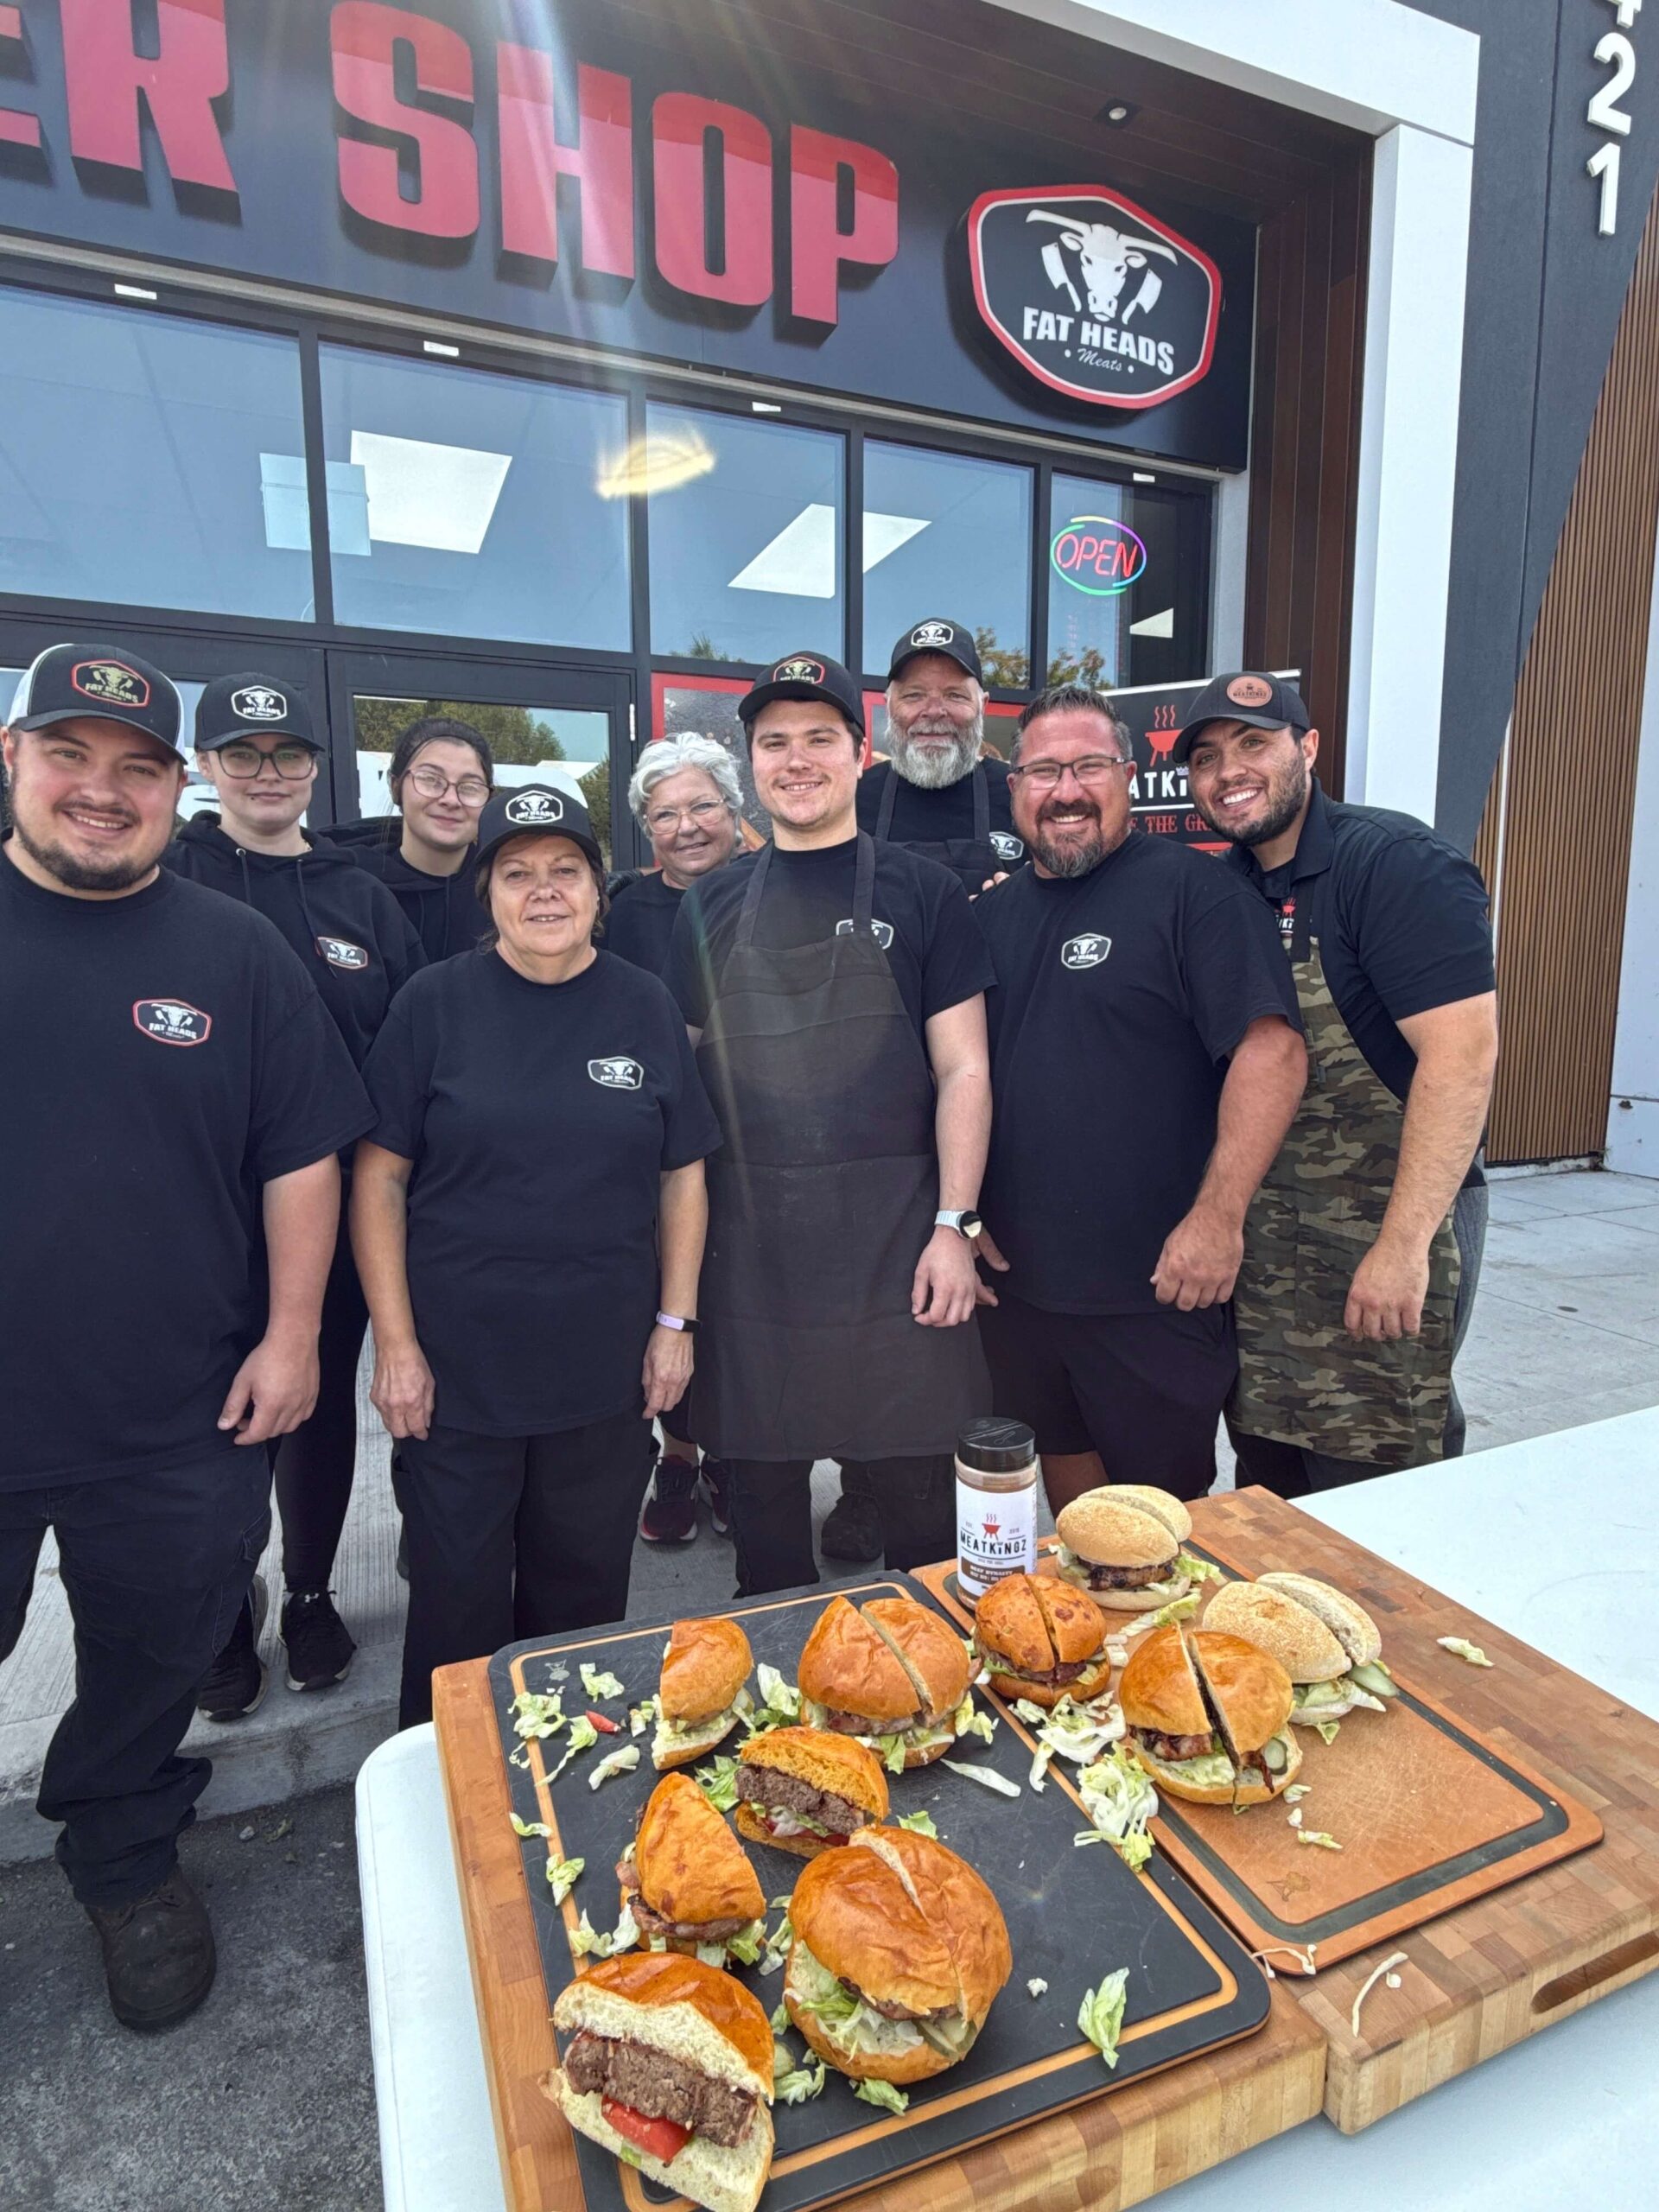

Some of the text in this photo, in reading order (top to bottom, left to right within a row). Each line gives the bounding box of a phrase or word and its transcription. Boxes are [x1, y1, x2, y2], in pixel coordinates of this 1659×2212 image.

[1586, 0, 1642, 236] 21
[330, 0, 899, 325] SHOP
[1023, 306, 1174, 375] FAT HEADS
[1077, 348, 1122, 372] Meats
[1056, 533, 1138, 577] OPEN
[86, 683, 104, 691] FAT
[105, 685, 138, 703] HEADS
[1145, 815, 1178, 835] THE
[149, 1022, 166, 1031] FAT
[168, 1025, 197, 1039] HEADS
